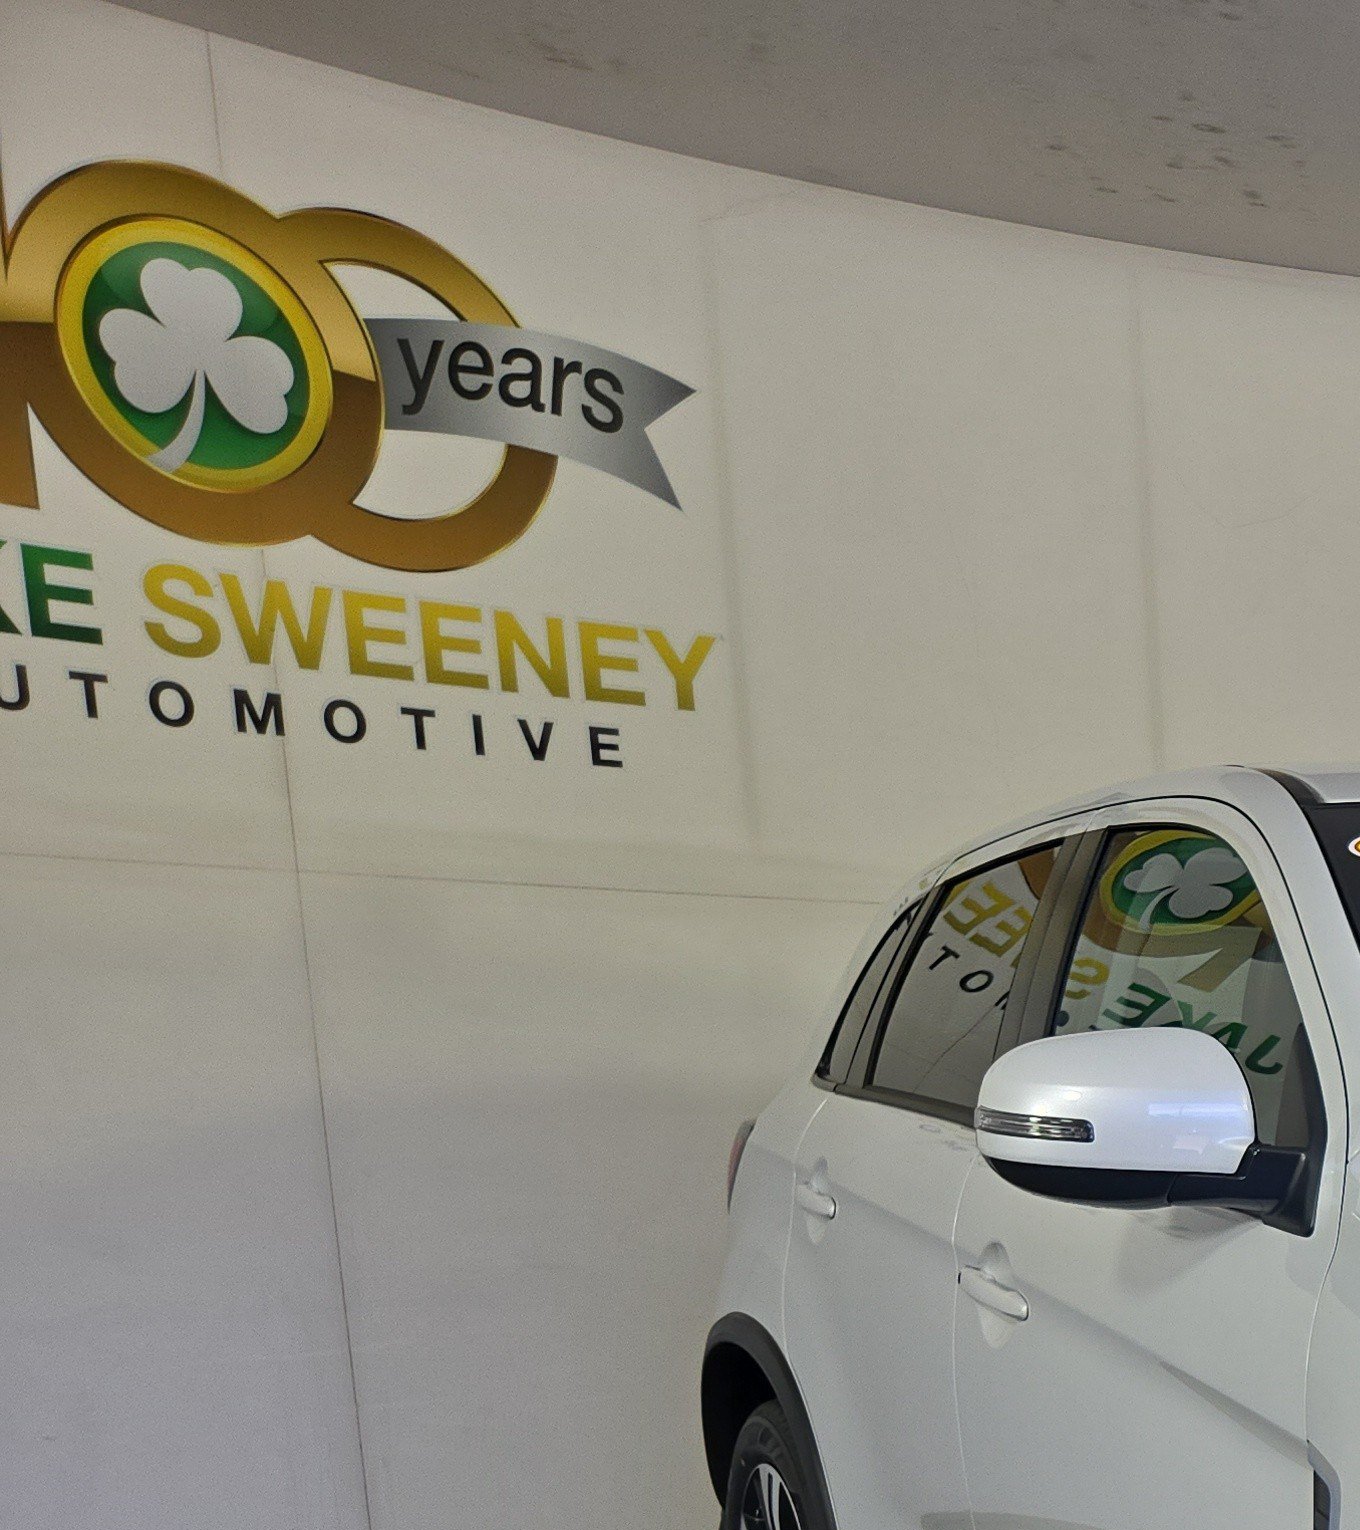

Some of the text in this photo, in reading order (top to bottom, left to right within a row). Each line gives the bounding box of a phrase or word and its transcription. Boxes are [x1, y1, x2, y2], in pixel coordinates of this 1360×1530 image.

[0, 160, 623, 573] 00 years
[142, 563, 716, 711] SWEENEY
[0, 665, 624, 768] UTOMOTIVE
